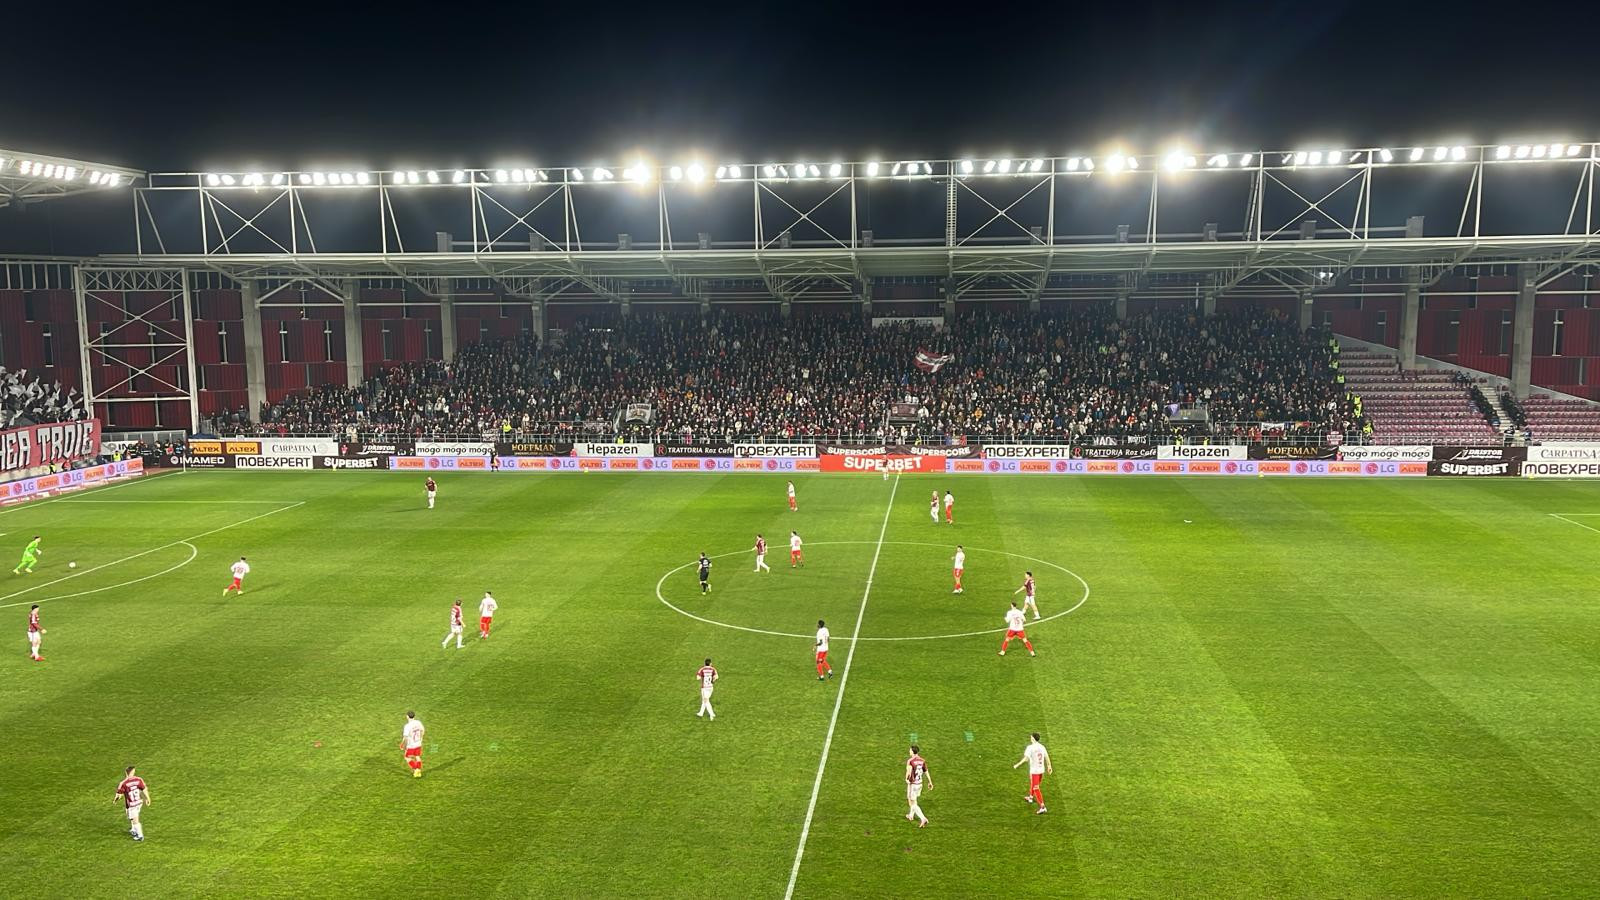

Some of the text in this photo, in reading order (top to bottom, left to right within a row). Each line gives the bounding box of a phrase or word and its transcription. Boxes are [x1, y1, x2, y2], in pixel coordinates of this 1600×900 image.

[272, 444, 317, 453] CARPATINA
[416, 446, 493, 455] mogo mogo mogo
[511, 443, 556, 451] HOFFMAN
[587, 444, 638, 455] Hepazen
[736, 446, 814, 457] MOBEXPERT
[827, 446, 887, 455] SUPERSCORE
[911, 446, 971, 456] SUPERSCORE
[1267, 446, 1319, 455] HOFFMAN
[985, 447, 1068, 457] MOBEXPERT
[1173, 446, 1230, 458] Hepazen
[1342, 450, 1430, 460] mogo mogo mogo
[1540, 448, 1597, 459] CARPATINA
[179, 456, 225, 464] IMAMED
[237, 456, 311, 467] MOBEXPERT
[324, 457, 379, 468] SUPERBET
[441, 459, 454, 467] LG
[502, 459, 515, 468] LG
[562, 460, 576, 468] LG
[655, 460, 668, 468] LG
[717, 460, 730, 469] LG
[844, 457, 923, 471] SUPERBET
[116, 463, 125, 473] LG
[779, 461, 792, 469] LG
[1002, 462, 1016, 470] LG
[1069, 462, 1083, 471] LG
[1136, 463, 1150, 471] LG
[1239, 463, 1254, 472] LG
[1310, 463, 1324, 472] LG
[1380, 463, 1395, 473] LG
[1441, 463, 1509, 475] SUPERBET
[72, 472, 82, 482] LG
[23, 482, 34, 493] LG
